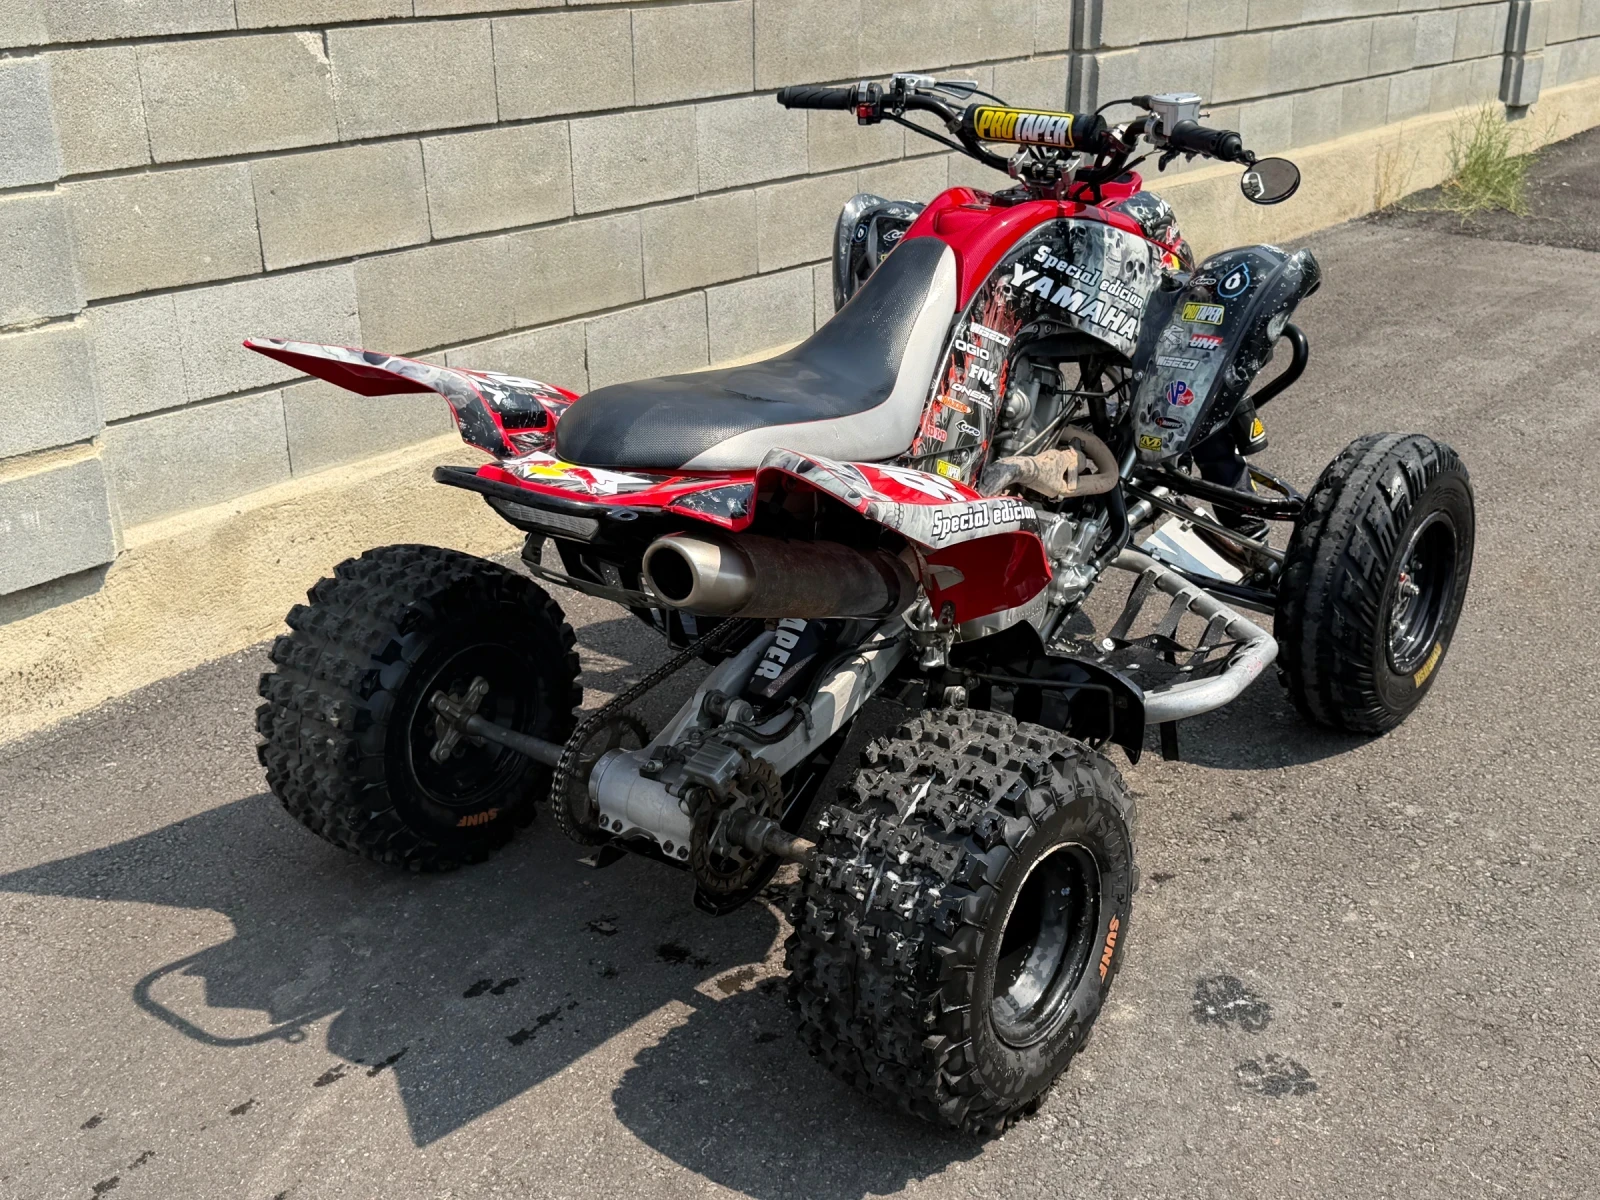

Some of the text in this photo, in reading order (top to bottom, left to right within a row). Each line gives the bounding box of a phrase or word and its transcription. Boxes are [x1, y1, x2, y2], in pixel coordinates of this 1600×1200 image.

[1033, 244, 1144, 309] Special edicion
[1010, 262, 1138, 340] YAMAHA
[1183, 303, 1223, 323] PROTAPER
[969, 321, 1011, 346] WISECO
[955, 339, 989, 361] OGIO
[1157, 355, 1199, 371] WISECO
[968, 363, 998, 386] FOX
[1169, 380, 1188, 407] VP
[932, 500, 1037, 539] Special edicion
[754, 617, 808, 680] APER
[456, 808, 500, 827] SUNF
[1099, 913, 1120, 984] SUNF
